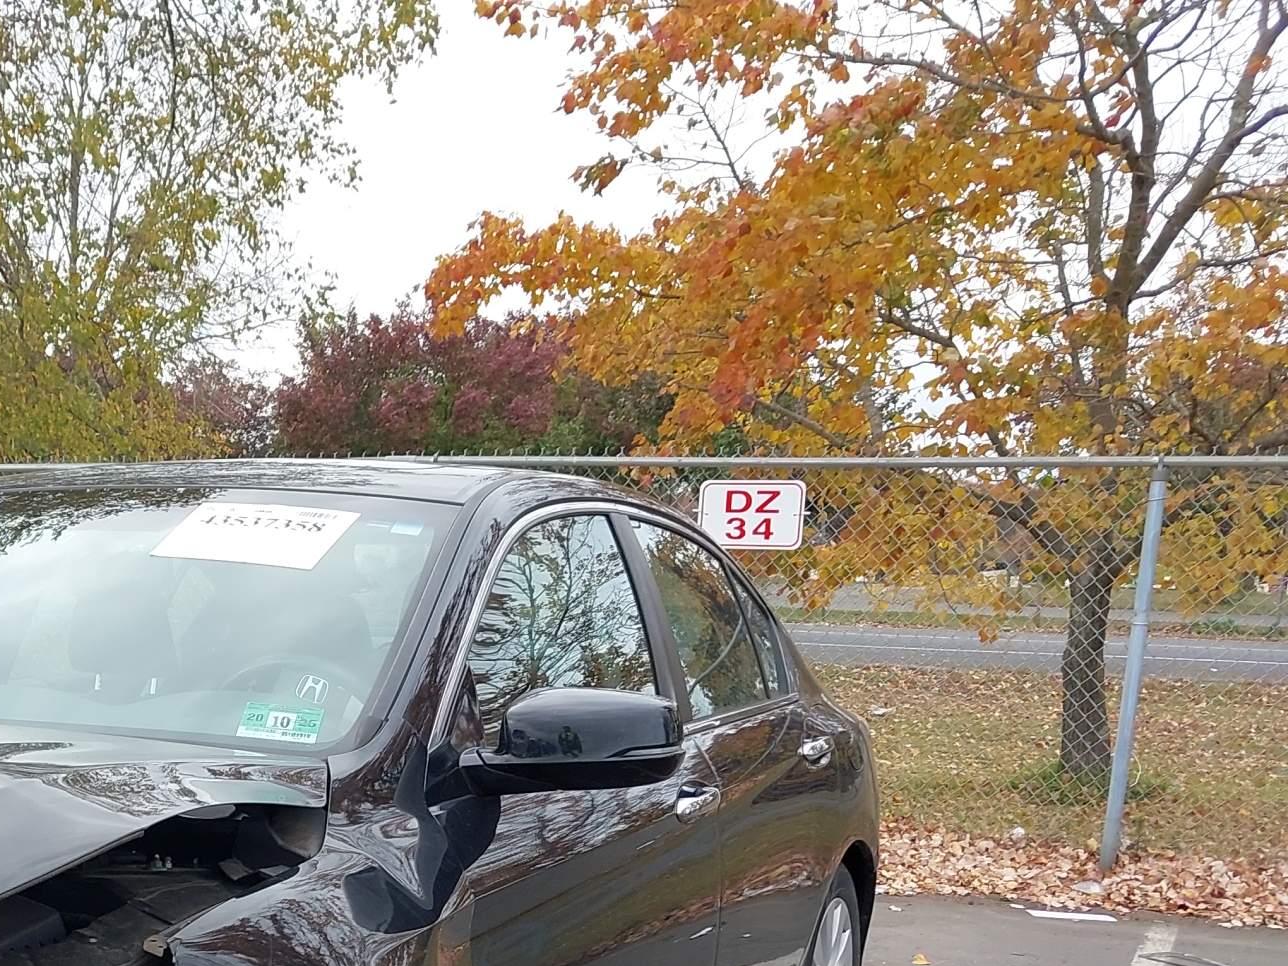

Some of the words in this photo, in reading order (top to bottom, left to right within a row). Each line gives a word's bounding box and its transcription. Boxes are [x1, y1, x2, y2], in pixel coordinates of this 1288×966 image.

[725, 490, 781, 513] DZ
[725, 517, 774, 540] 34
[271, 715, 291, 729] 10
[297, 719, 317, 728] 25
